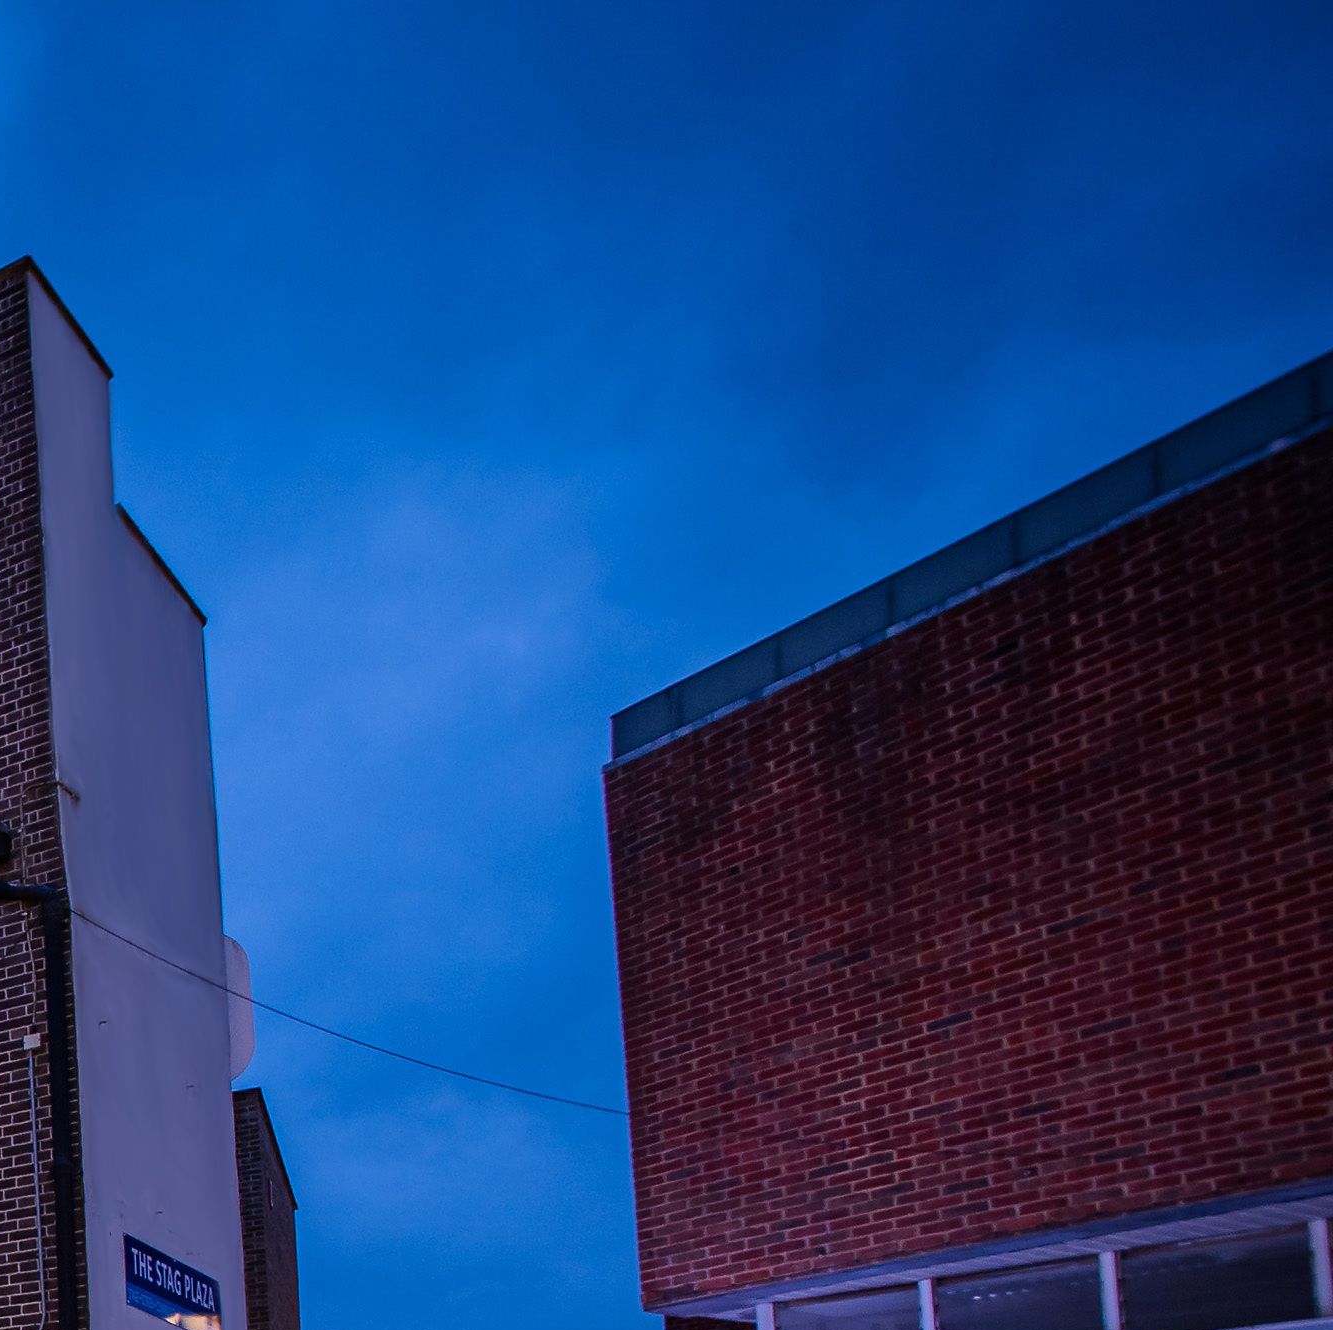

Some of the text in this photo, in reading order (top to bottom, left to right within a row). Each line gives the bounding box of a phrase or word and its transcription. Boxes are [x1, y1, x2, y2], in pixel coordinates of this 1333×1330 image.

[131, 1247, 153, 1282] THE
[155, 1260, 181, 1296] STAG
[184, 1274, 215, 1312] PLAZA
